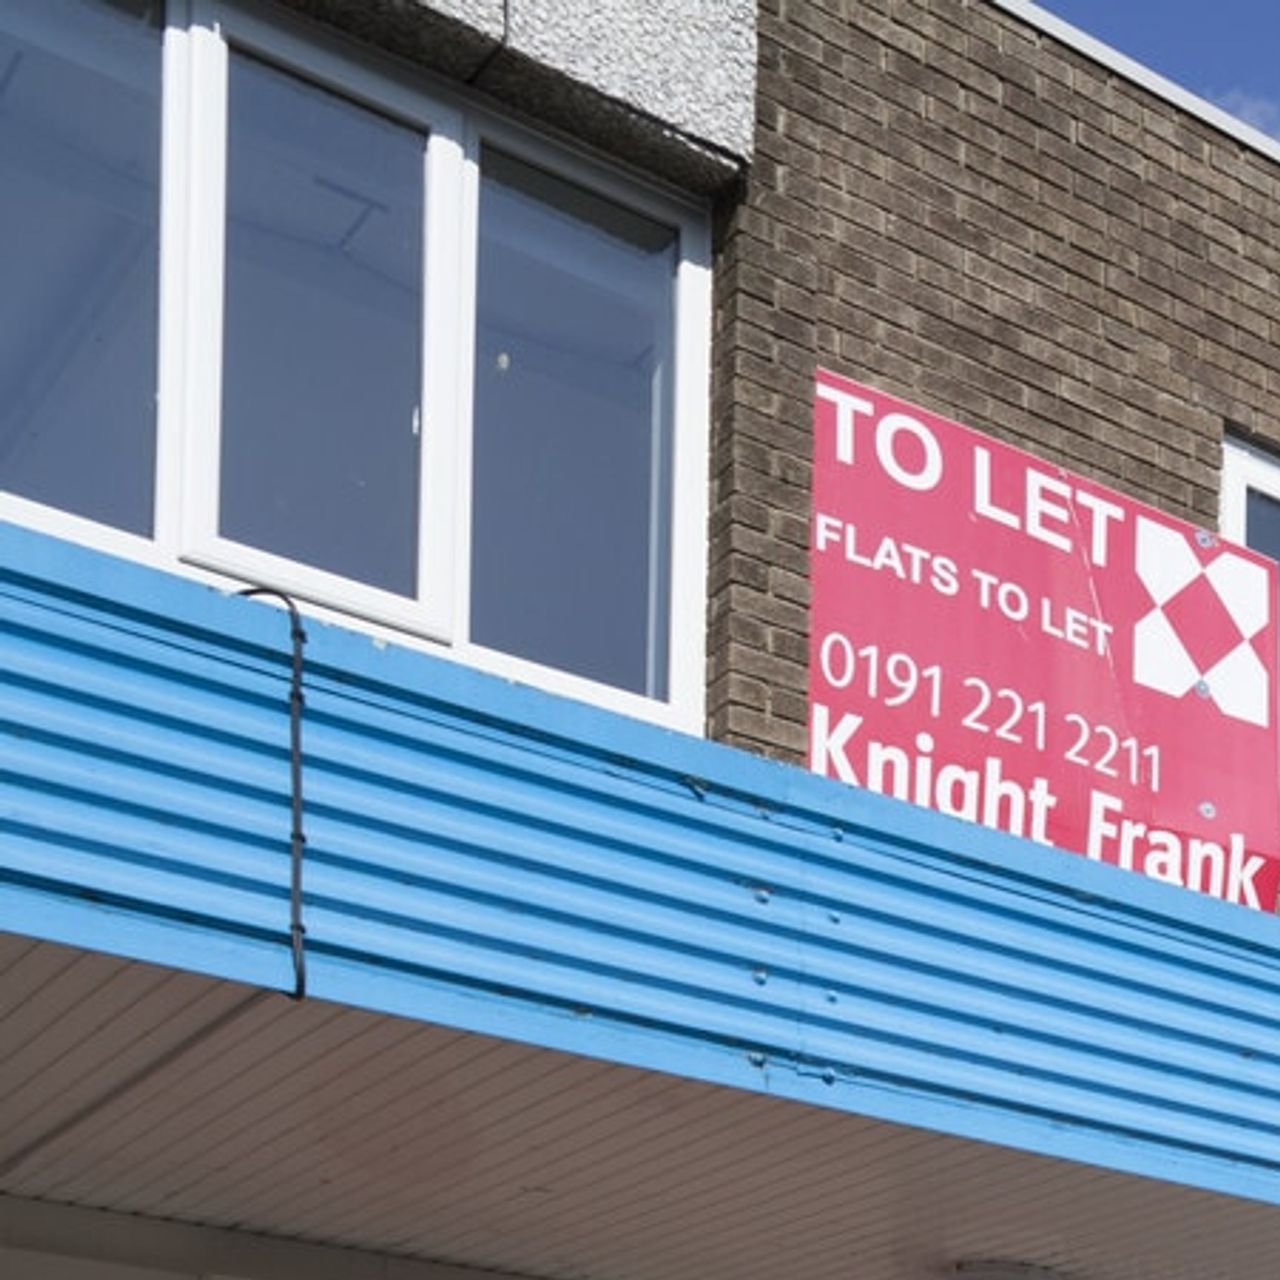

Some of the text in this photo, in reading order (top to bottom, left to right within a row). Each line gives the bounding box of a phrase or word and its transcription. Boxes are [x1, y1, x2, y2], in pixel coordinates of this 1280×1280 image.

[816, 383, 1125, 566] TO LET
[816, 514, 1113, 655] FLATS TO LET
[819, 631, 1161, 793] 0191 221 2211
[810, 704, 1267, 913] Knight Frank
